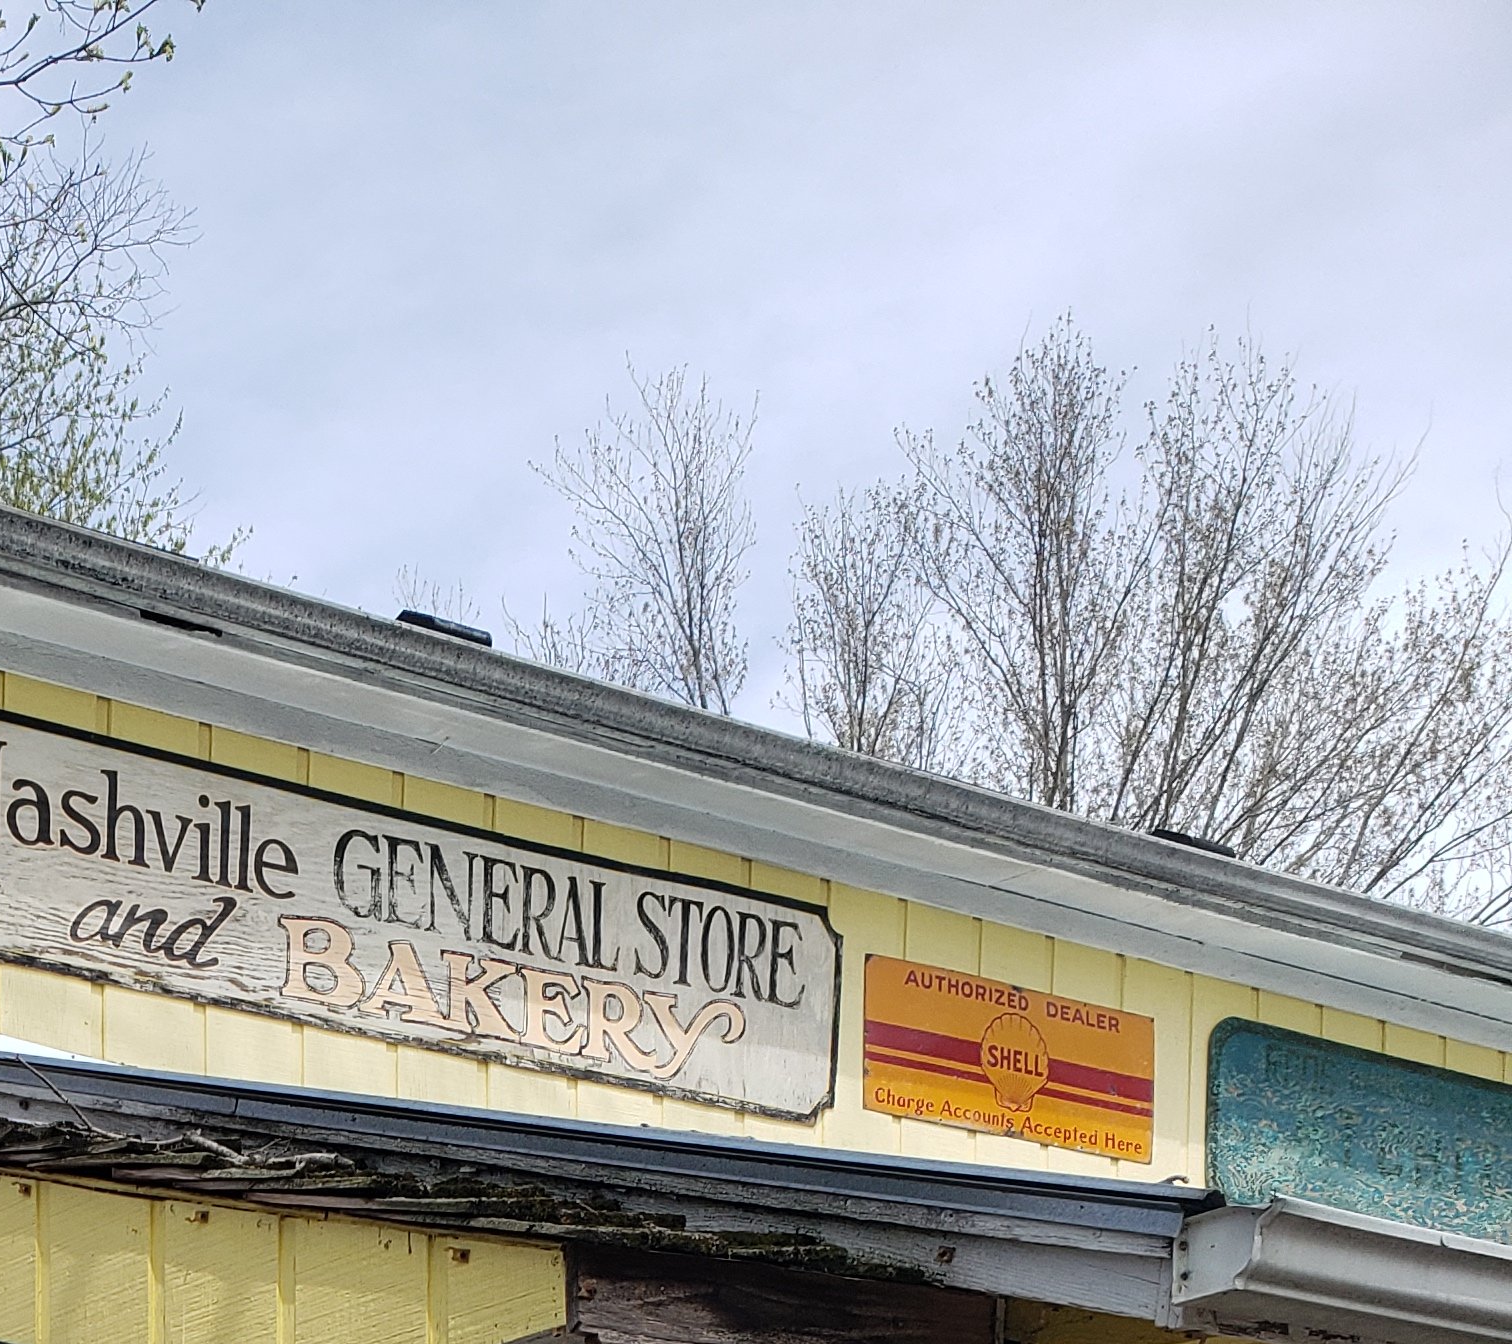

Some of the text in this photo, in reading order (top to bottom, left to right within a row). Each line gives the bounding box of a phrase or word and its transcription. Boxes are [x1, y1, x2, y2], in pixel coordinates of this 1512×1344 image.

[333, 829, 620, 973] GENERAL
[634, 889, 805, 1009] STORE
[69, 896, 746, 1082] and BAKERY
[903, 968, 1121, 1034] AUTHORIZED DEALER
[988, 1044, 1045, 1078] SHELL
[873, 1086, 1144, 1156] Charge Accounts Accepted Here
